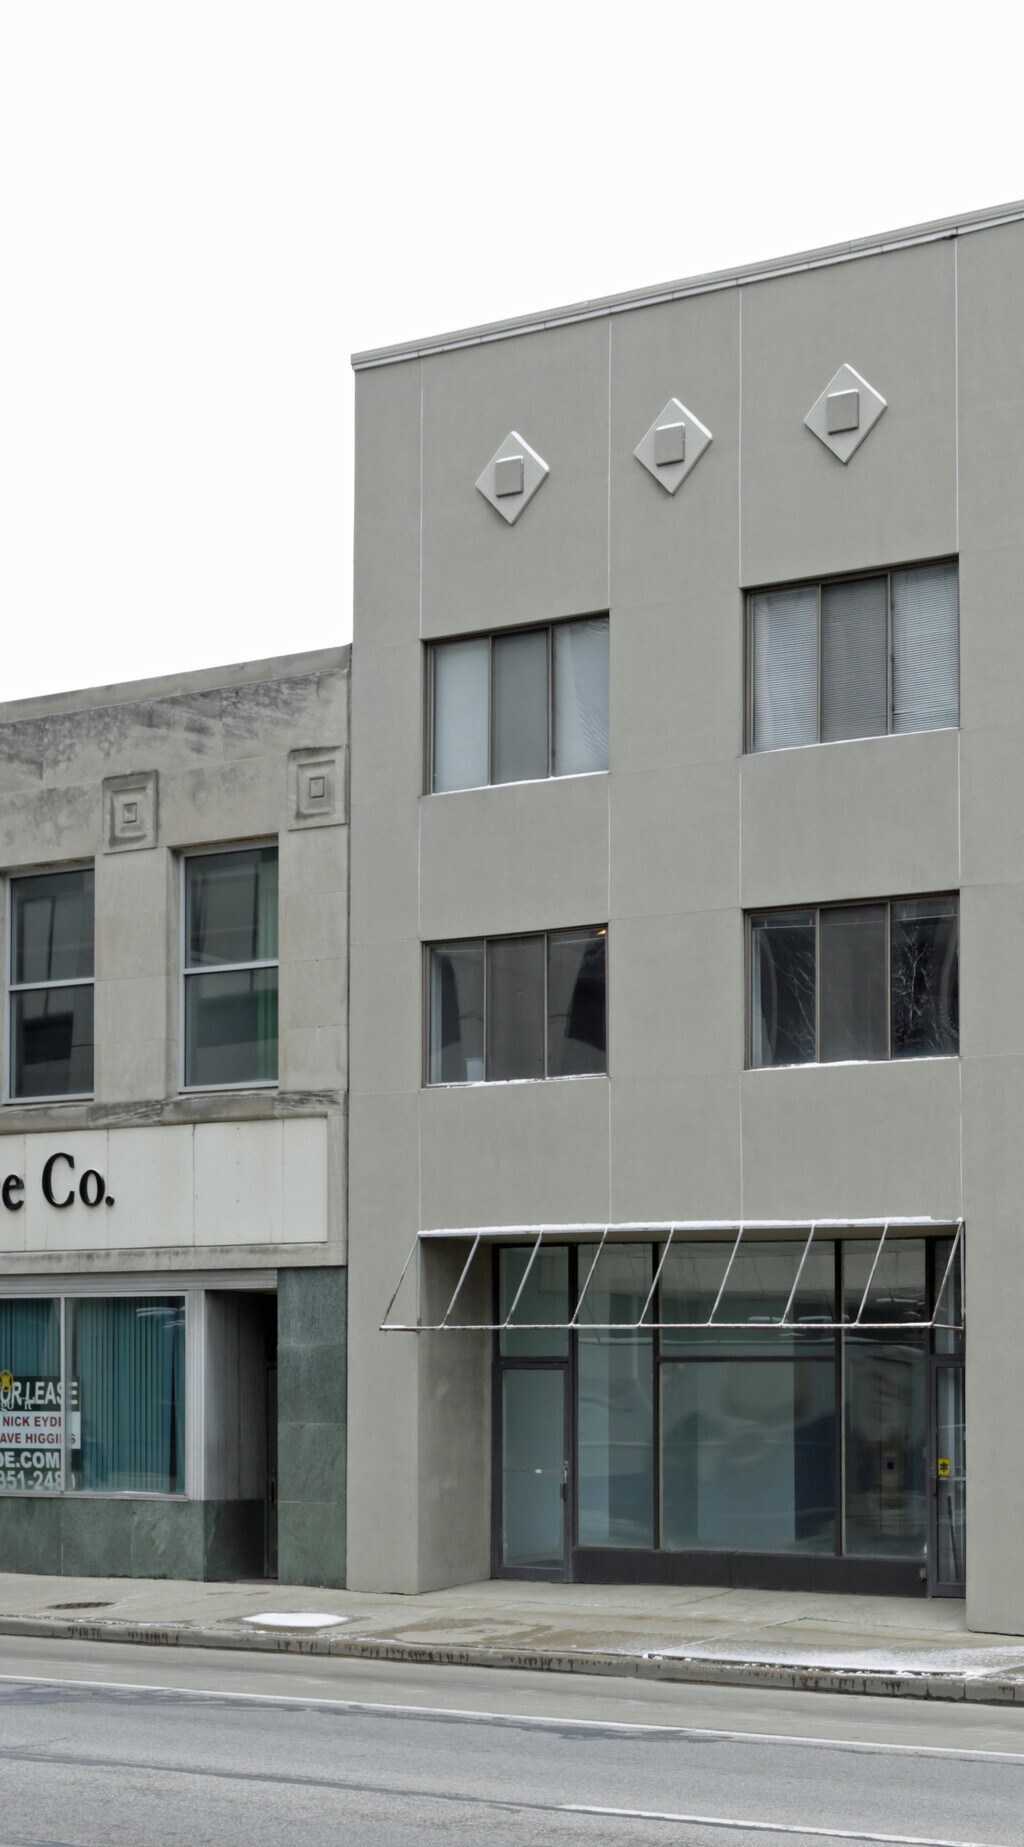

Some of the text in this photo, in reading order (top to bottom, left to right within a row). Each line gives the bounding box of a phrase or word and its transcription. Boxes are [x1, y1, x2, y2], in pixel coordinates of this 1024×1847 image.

[0, 1152, 116, 1212] e Co.
[0, 1381, 22, 1406] OR
[3, 1416, 30, 1427] NICK
[25, 1433, 76, 1445] HIGGIS
